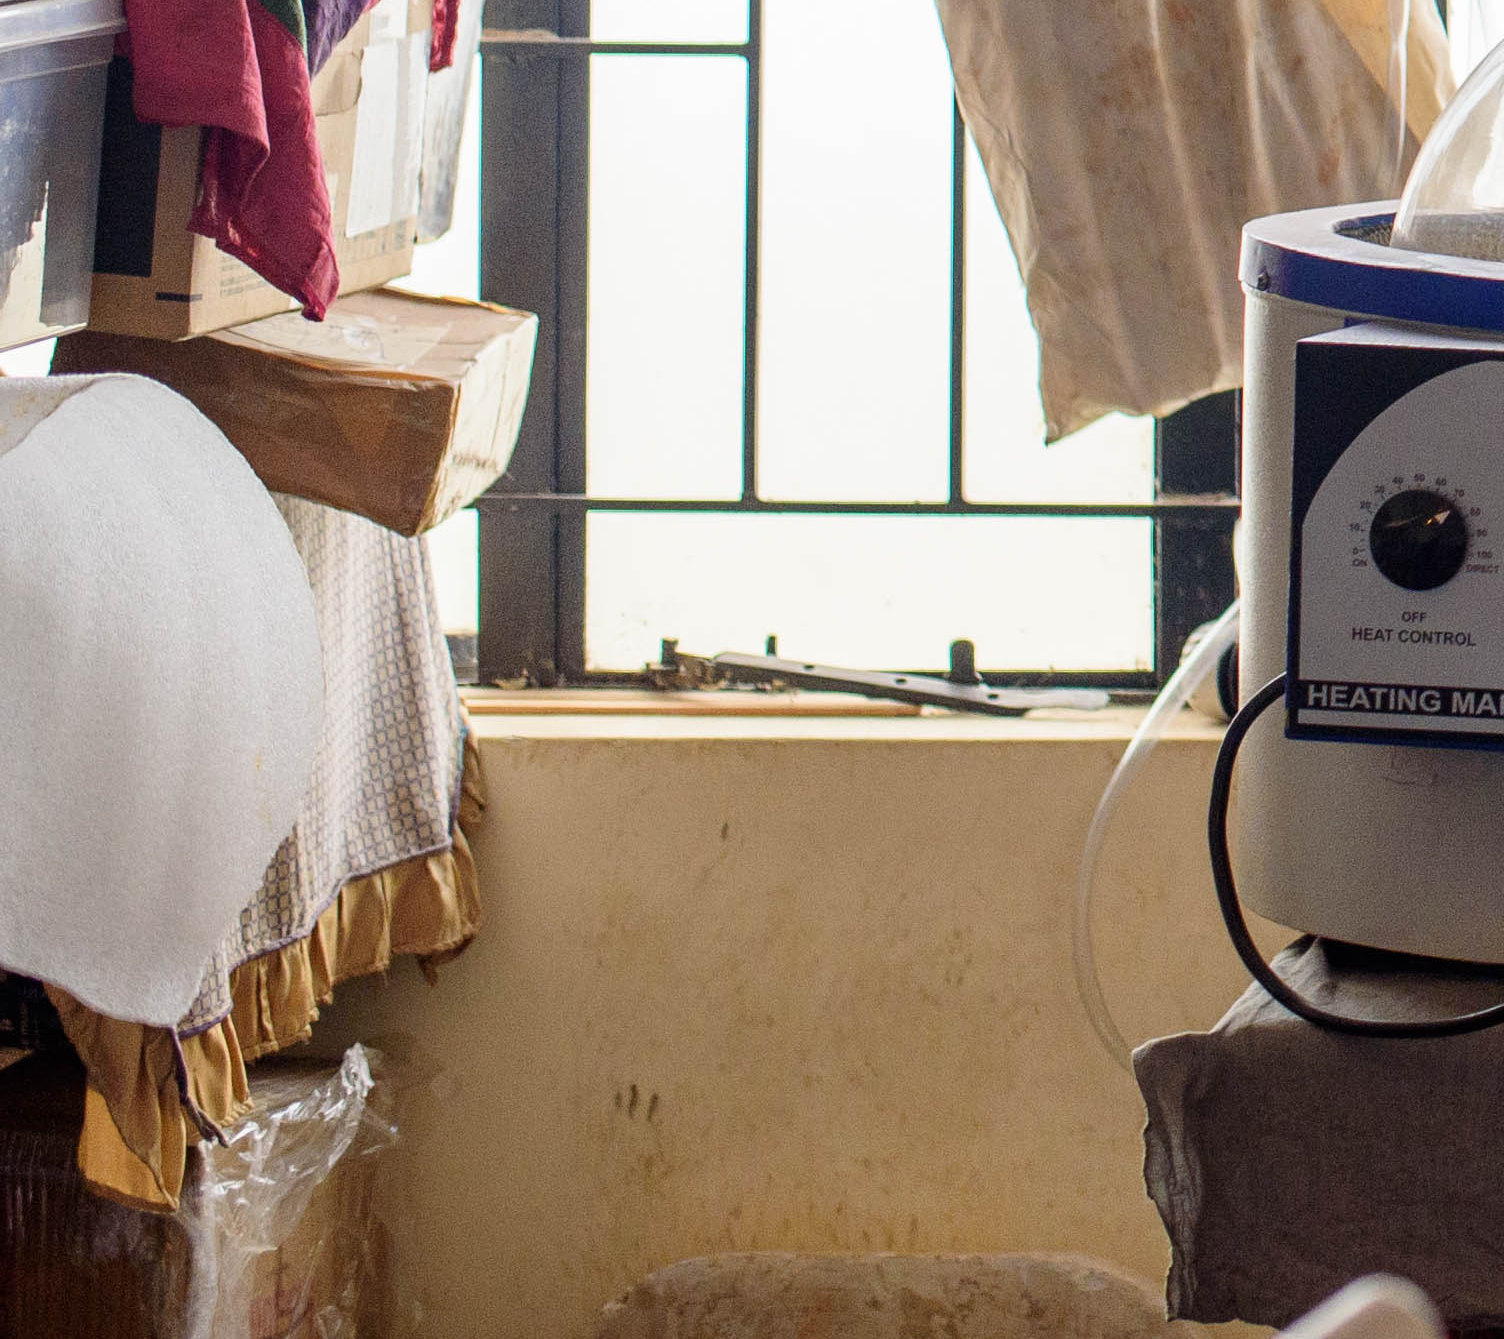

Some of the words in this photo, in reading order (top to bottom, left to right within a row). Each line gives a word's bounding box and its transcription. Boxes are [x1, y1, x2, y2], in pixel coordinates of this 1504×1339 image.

[1465, 563, 1499, 573] DIRECT
[1401, 611, 1427, 623] OFF
[1351, 627, 1394, 642] HEAT
[1397, 629, 1477, 647] CONTROL
[1306, 683, 1442, 713] HEATING
